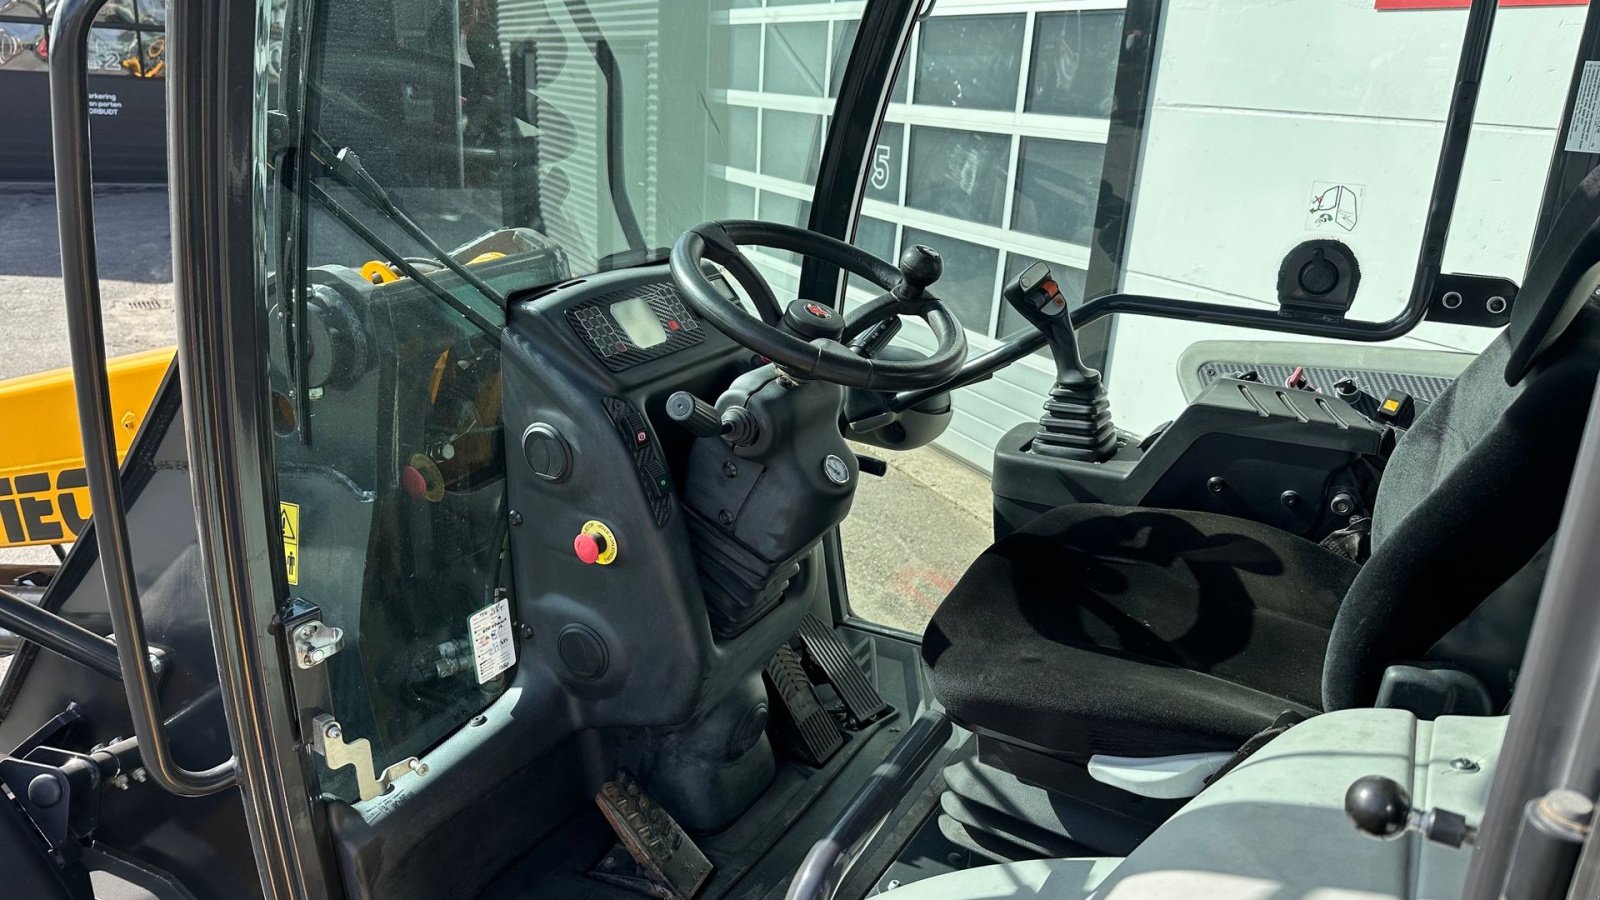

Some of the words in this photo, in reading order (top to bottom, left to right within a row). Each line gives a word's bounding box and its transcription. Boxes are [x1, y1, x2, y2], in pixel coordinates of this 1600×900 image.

[88, 93, 116, 102] arkering
[89, 108, 118, 116] ORBUDT
[871, 144, 890, 190] 5
